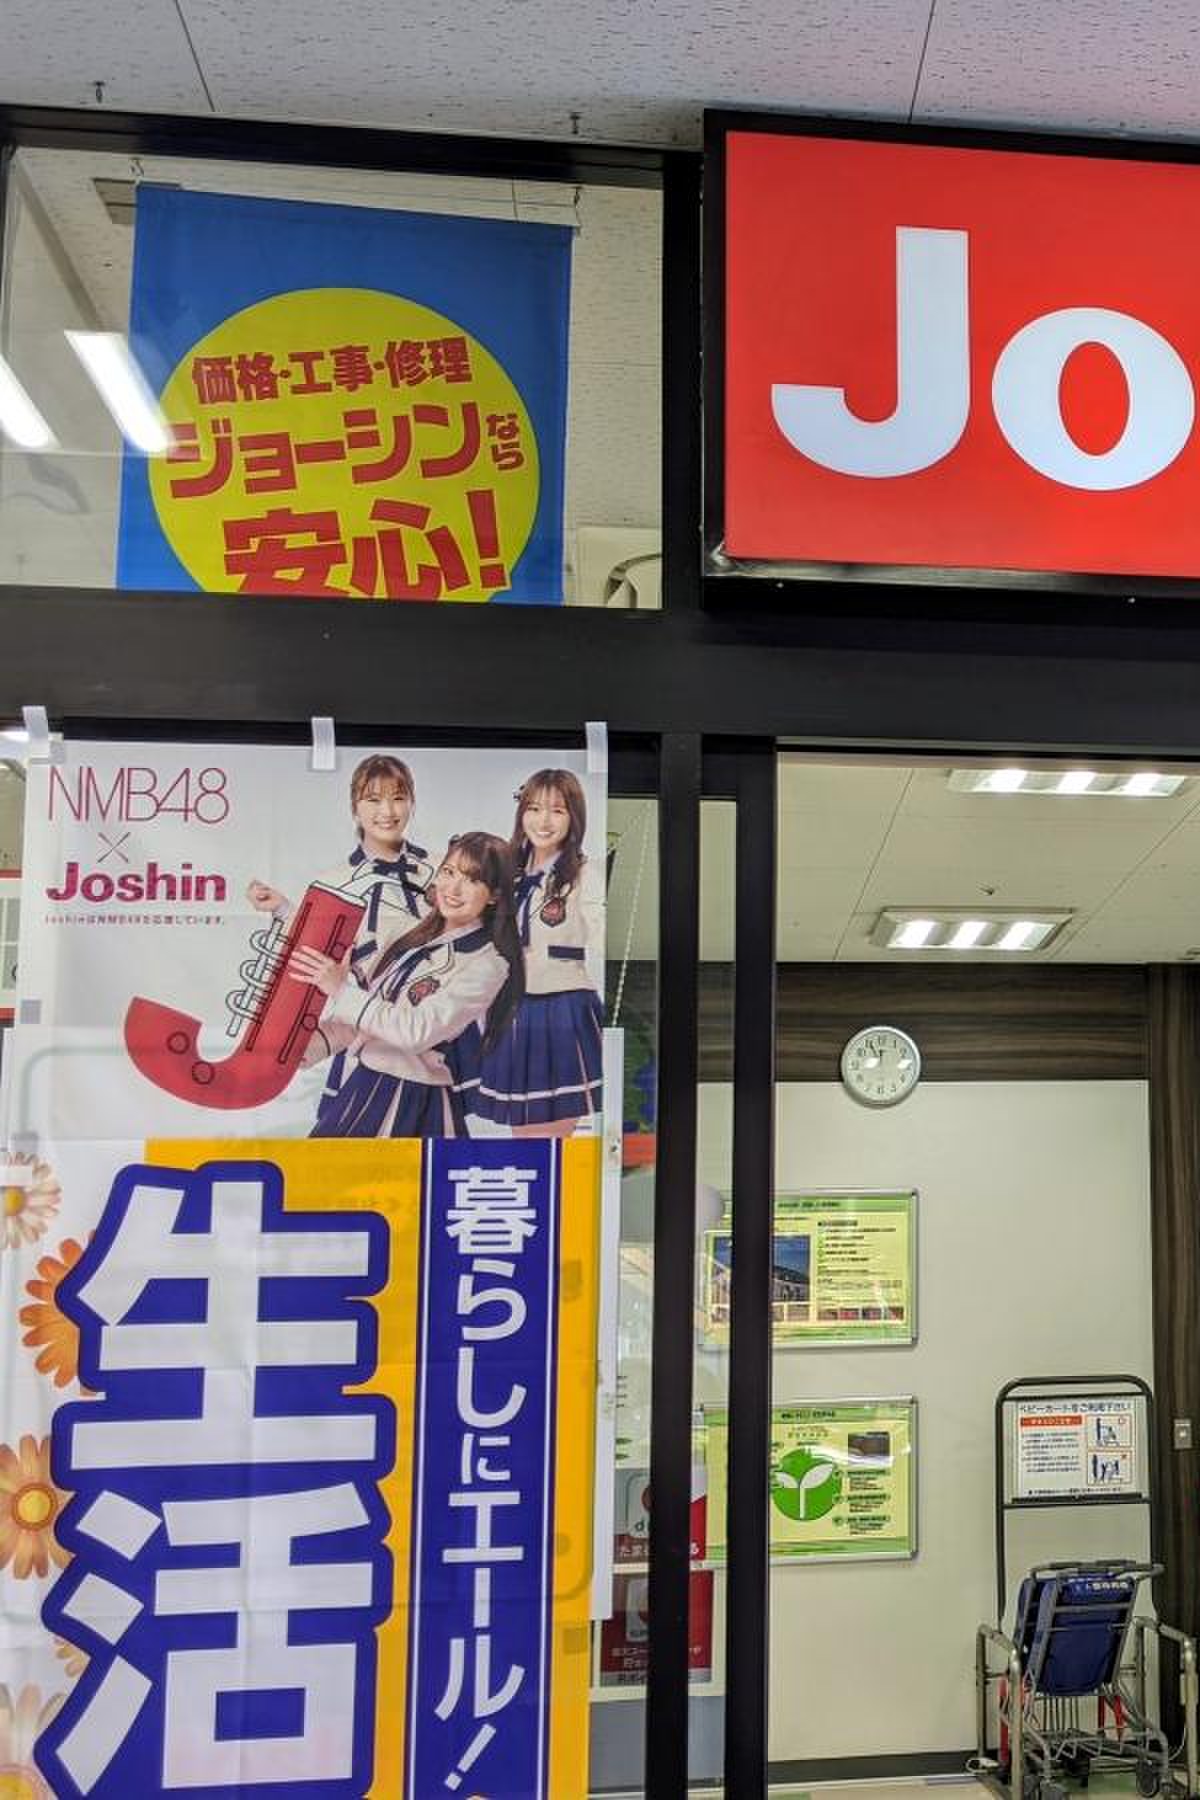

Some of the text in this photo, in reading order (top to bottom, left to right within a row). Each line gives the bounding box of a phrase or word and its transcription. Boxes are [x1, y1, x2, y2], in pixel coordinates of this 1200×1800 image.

[46, 862, 227, 903] Joshin
[48, 766, 230, 824] NMB48
[55, 1181, 377, 1796] 生活
[434, 1166, 539, 1791] 暮らしにエール！
